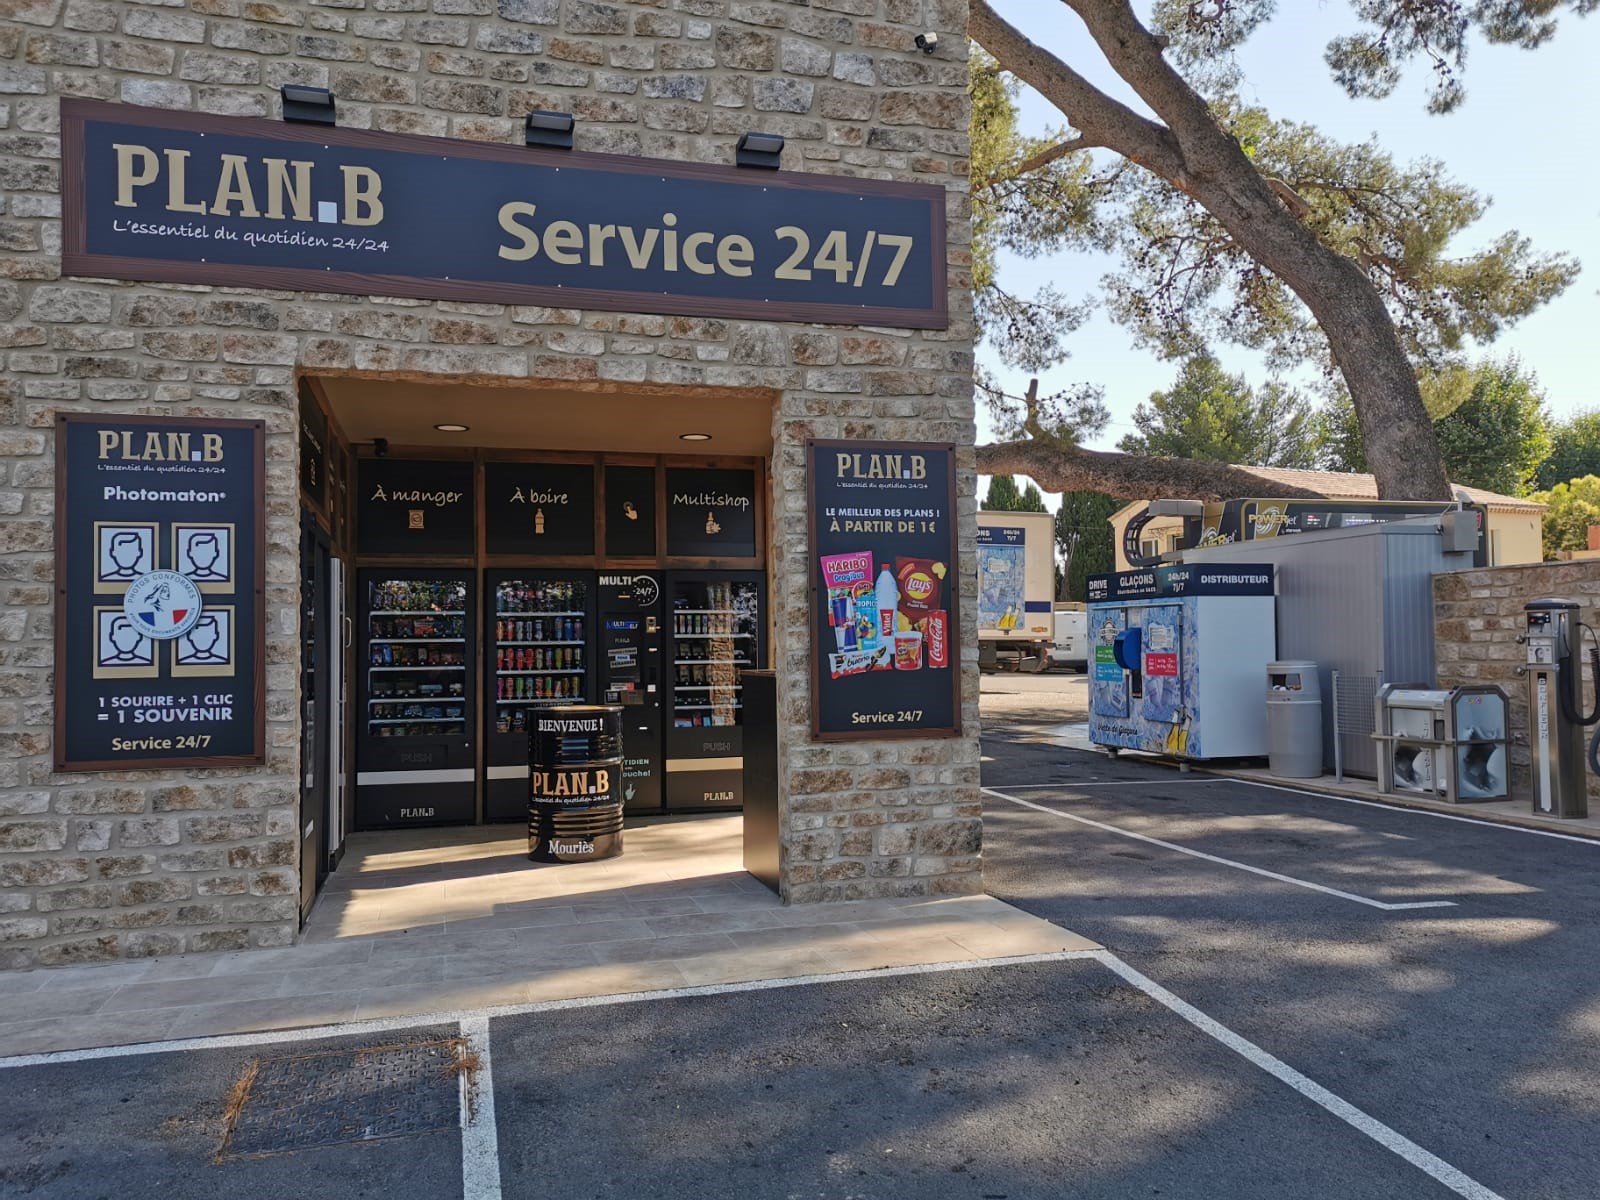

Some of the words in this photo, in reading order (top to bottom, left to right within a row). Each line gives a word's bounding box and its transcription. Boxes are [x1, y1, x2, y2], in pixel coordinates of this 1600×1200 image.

[112, 219, 209, 238] L'essentiel
[214, 225, 238, 242] du
[243, 229, 329, 248] quotidien
[332, 236, 390, 252] 24/24
[497, 201, 755, 277] Service
[774, 226, 914, 288] 24/7
[143, 464, 155, 472] du
[156, 463, 197, 474] quotidien
[198, 466, 227, 474] 24/24
[371, 484, 387, 501] À
[392, 490, 463, 507] manger
[510, 486, 525, 503] À
[530, 488, 569, 504] boire
[673, 491, 750, 512] Multishop
[825, 507, 836, 516] LE
[838, 507, 882, 517] MEILLEUR
[884, 508, 902, 517] DES
[904, 509, 934, 518] PLANS
[830, 517, 840, 532] À
[845, 520, 894, 533] PARTIR
[898, 521, 915, 533] DE
[827, 558, 868, 573] HARIBO
[599, 576, 632, 586] MULTI
[1088, 579, 1108, 590] DRIVE
[1119, 574, 1154, 588] GLAÇONS
[1200, 574, 1269, 585] DISTRIBUTEUR
[128, 577, 150, 603] PHOTOS
[152, 573, 197, 599] CONFORMES
[635, 587, 653, 597] 24/7
[99, 696, 105, 708] 1
[111, 695, 174, 708] SOURIRE
[192, 695, 199, 705] 1
[204, 694, 233, 705] CLIC
[117, 709, 125, 723] 1
[134, 707, 233, 723] SOUVENIR
[851, 711, 895, 724] Service
[897, 709, 923, 722] 24/7
[538, 719, 598, 732] BIENVENUE
[111, 736, 172, 751] Service
[175, 734, 212, 749] 24/7
[548, 840, 594, 855] Mouriès
